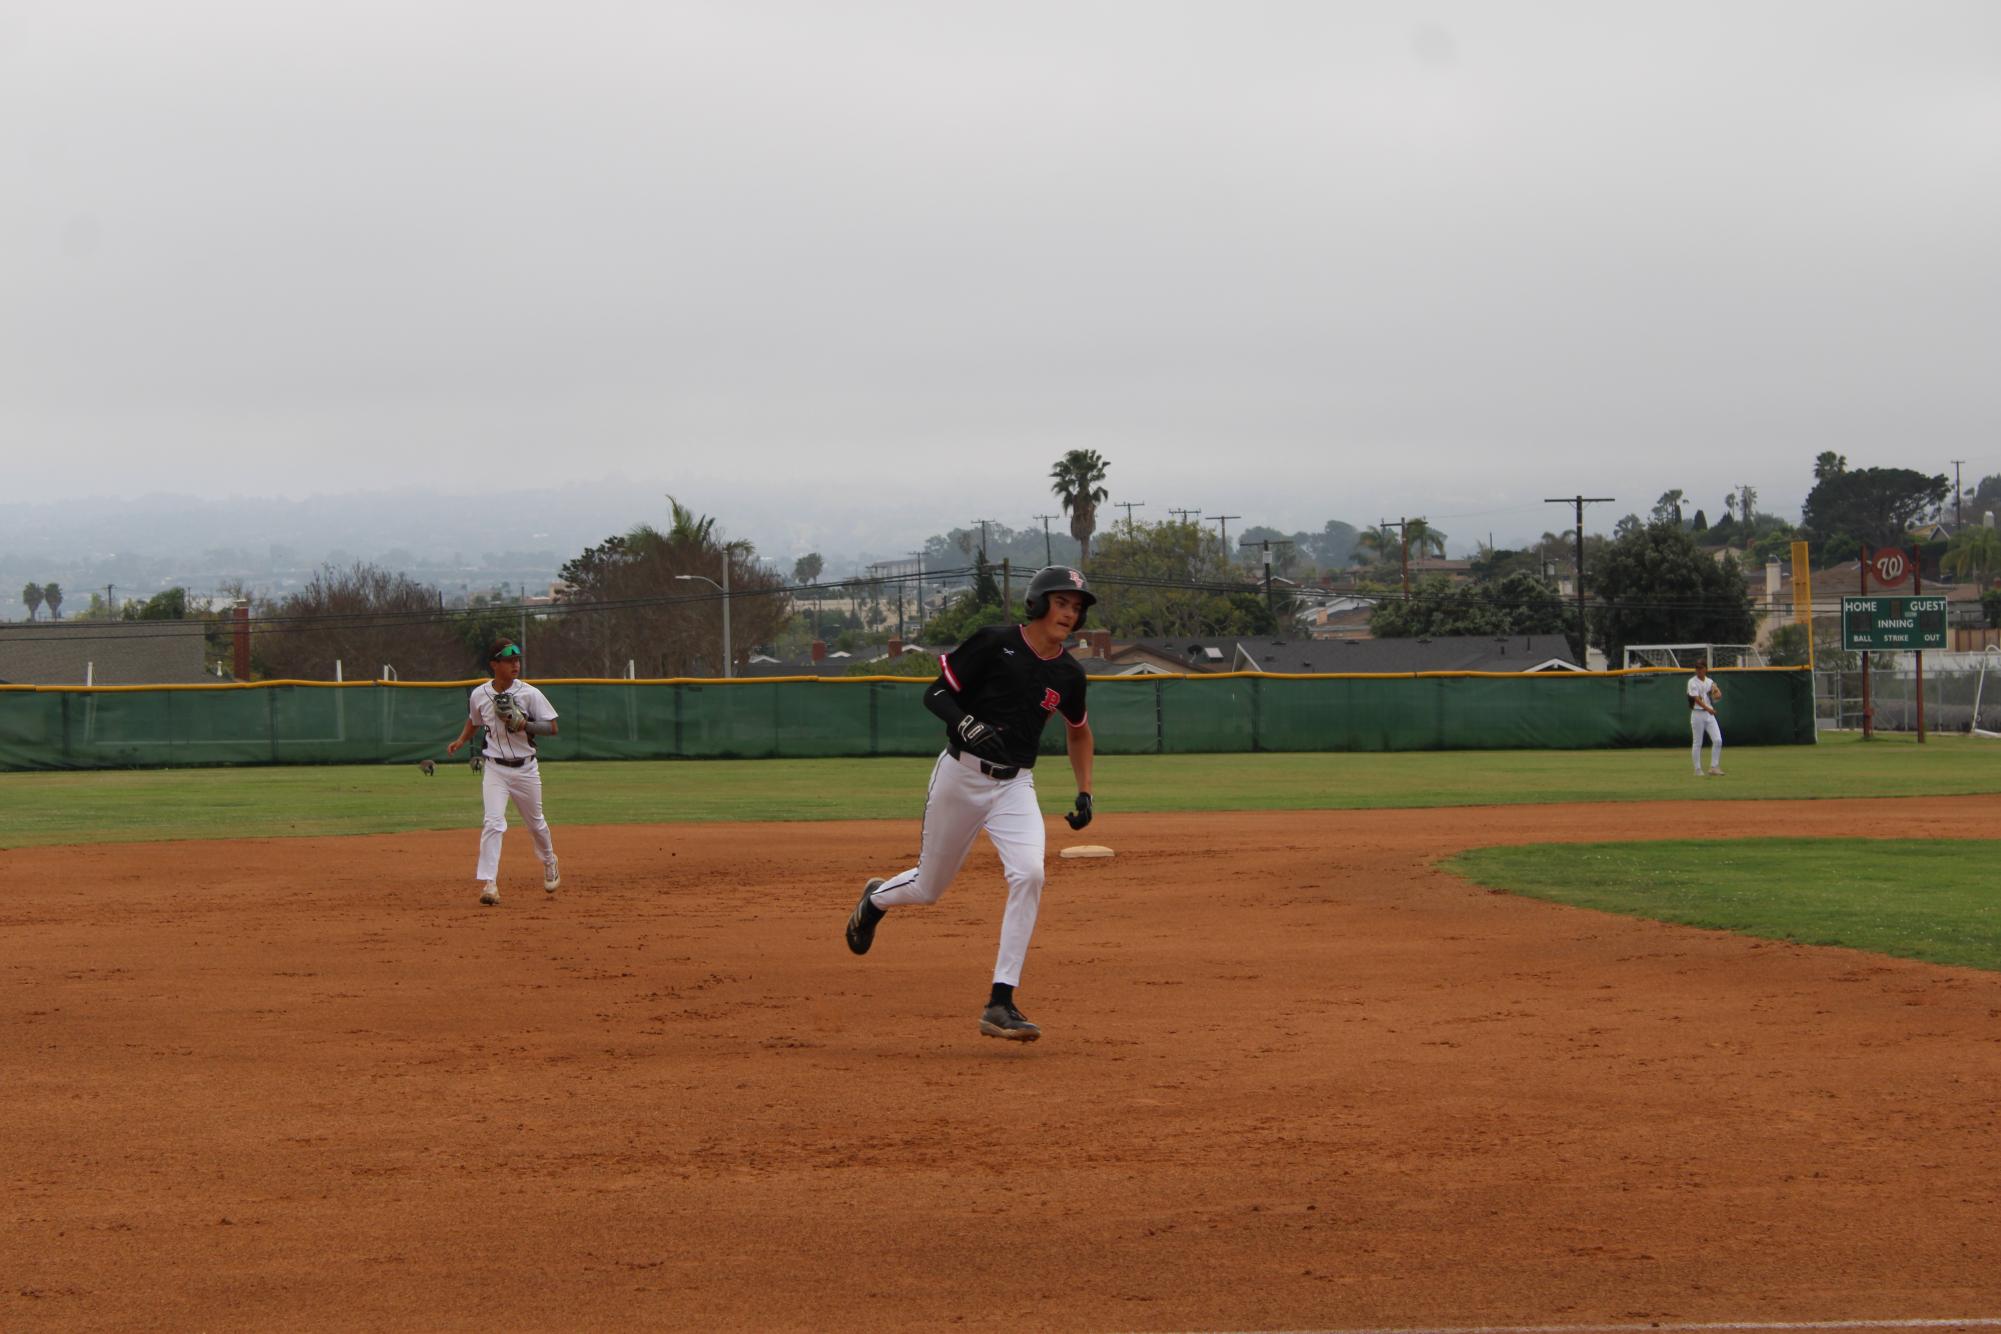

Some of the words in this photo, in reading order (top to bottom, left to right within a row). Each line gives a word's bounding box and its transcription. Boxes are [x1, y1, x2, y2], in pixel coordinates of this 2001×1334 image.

[1877, 554, 1904, 581] W
[1845, 601, 1877, 612] HOME
[1910, 600, 1946, 612] GUEST
[1878, 619, 1914, 628] INNING
[1853, 634, 1872, 642] BALL
[1884, 634, 1909, 642] STRIKE
[1924, 633, 1940, 641] OUT
